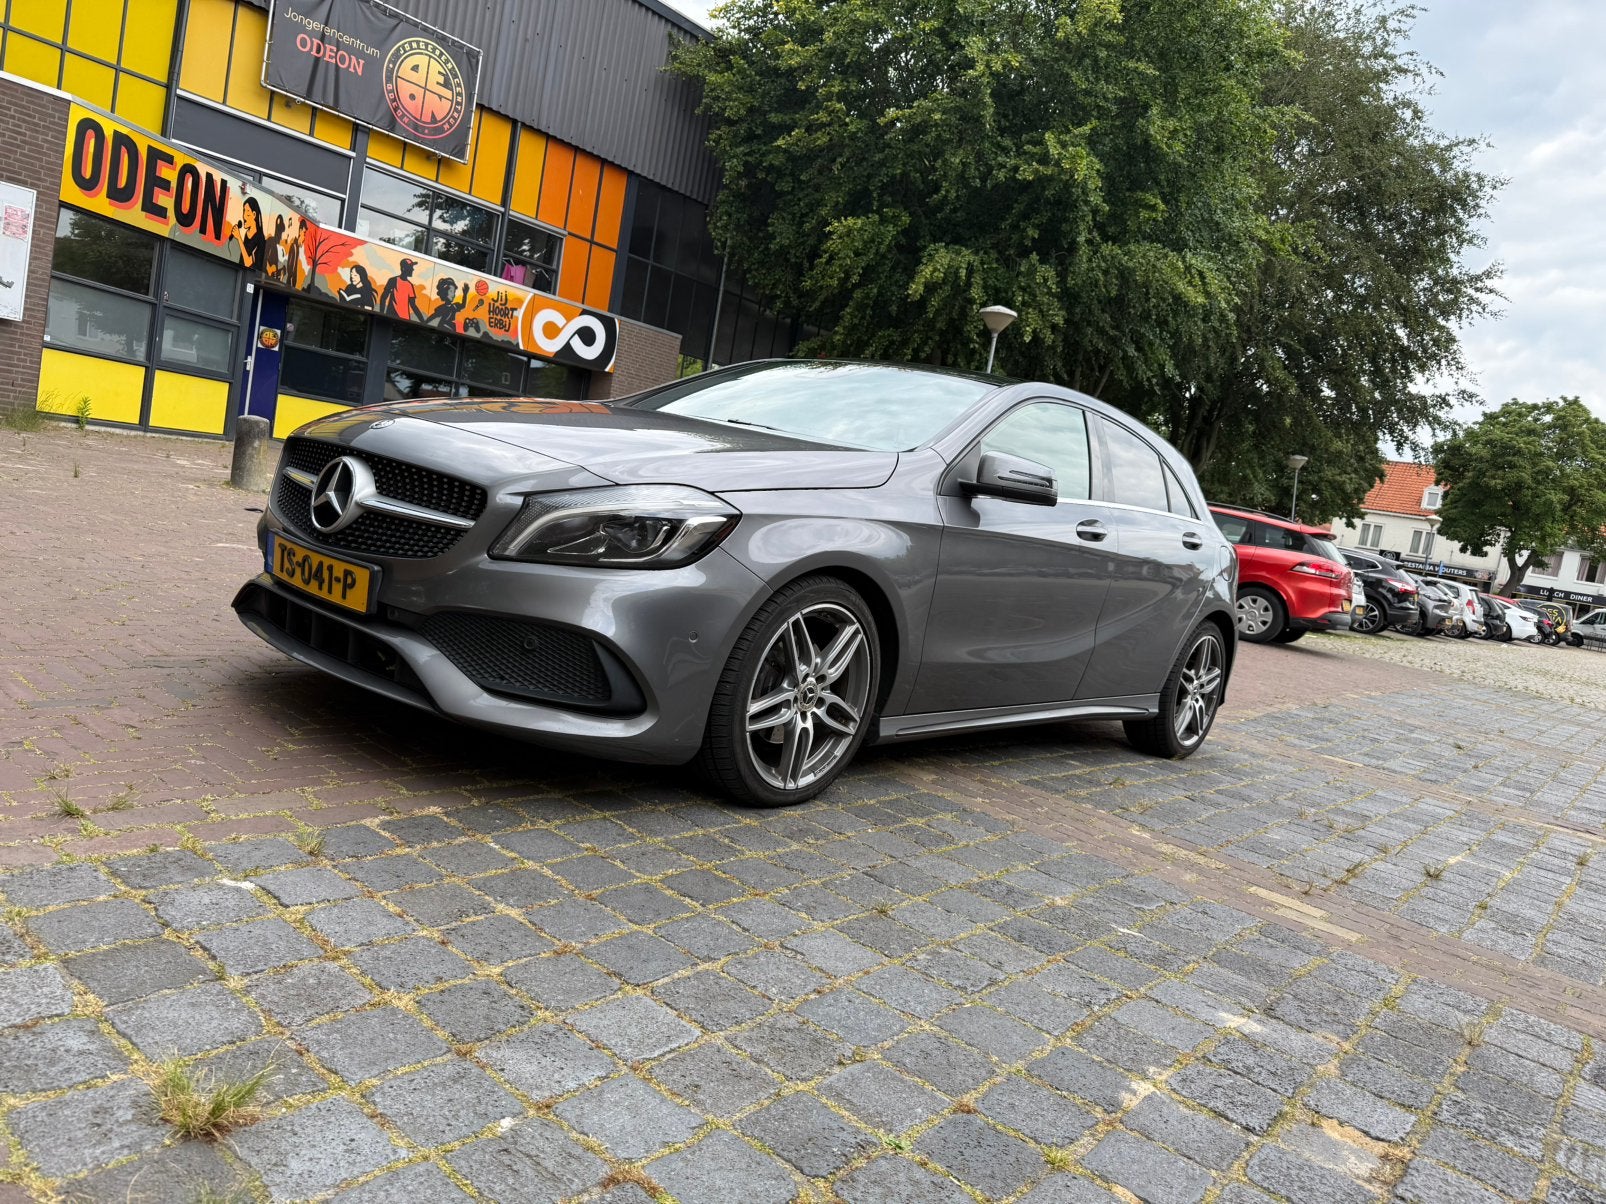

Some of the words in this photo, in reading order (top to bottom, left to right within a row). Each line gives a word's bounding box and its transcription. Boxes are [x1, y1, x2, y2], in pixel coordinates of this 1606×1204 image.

[284, 7, 380, 58] Jongerencentrum
[296, 33, 365, 76] ODEON
[71, 117, 229, 244] ODEON
[488, 302, 518, 320] HOORT
[278, 542, 357, 600] TS-041-P
[1540, 589, 1565, 598] LUCH
[1570, 593, 1593, 603] DINER
